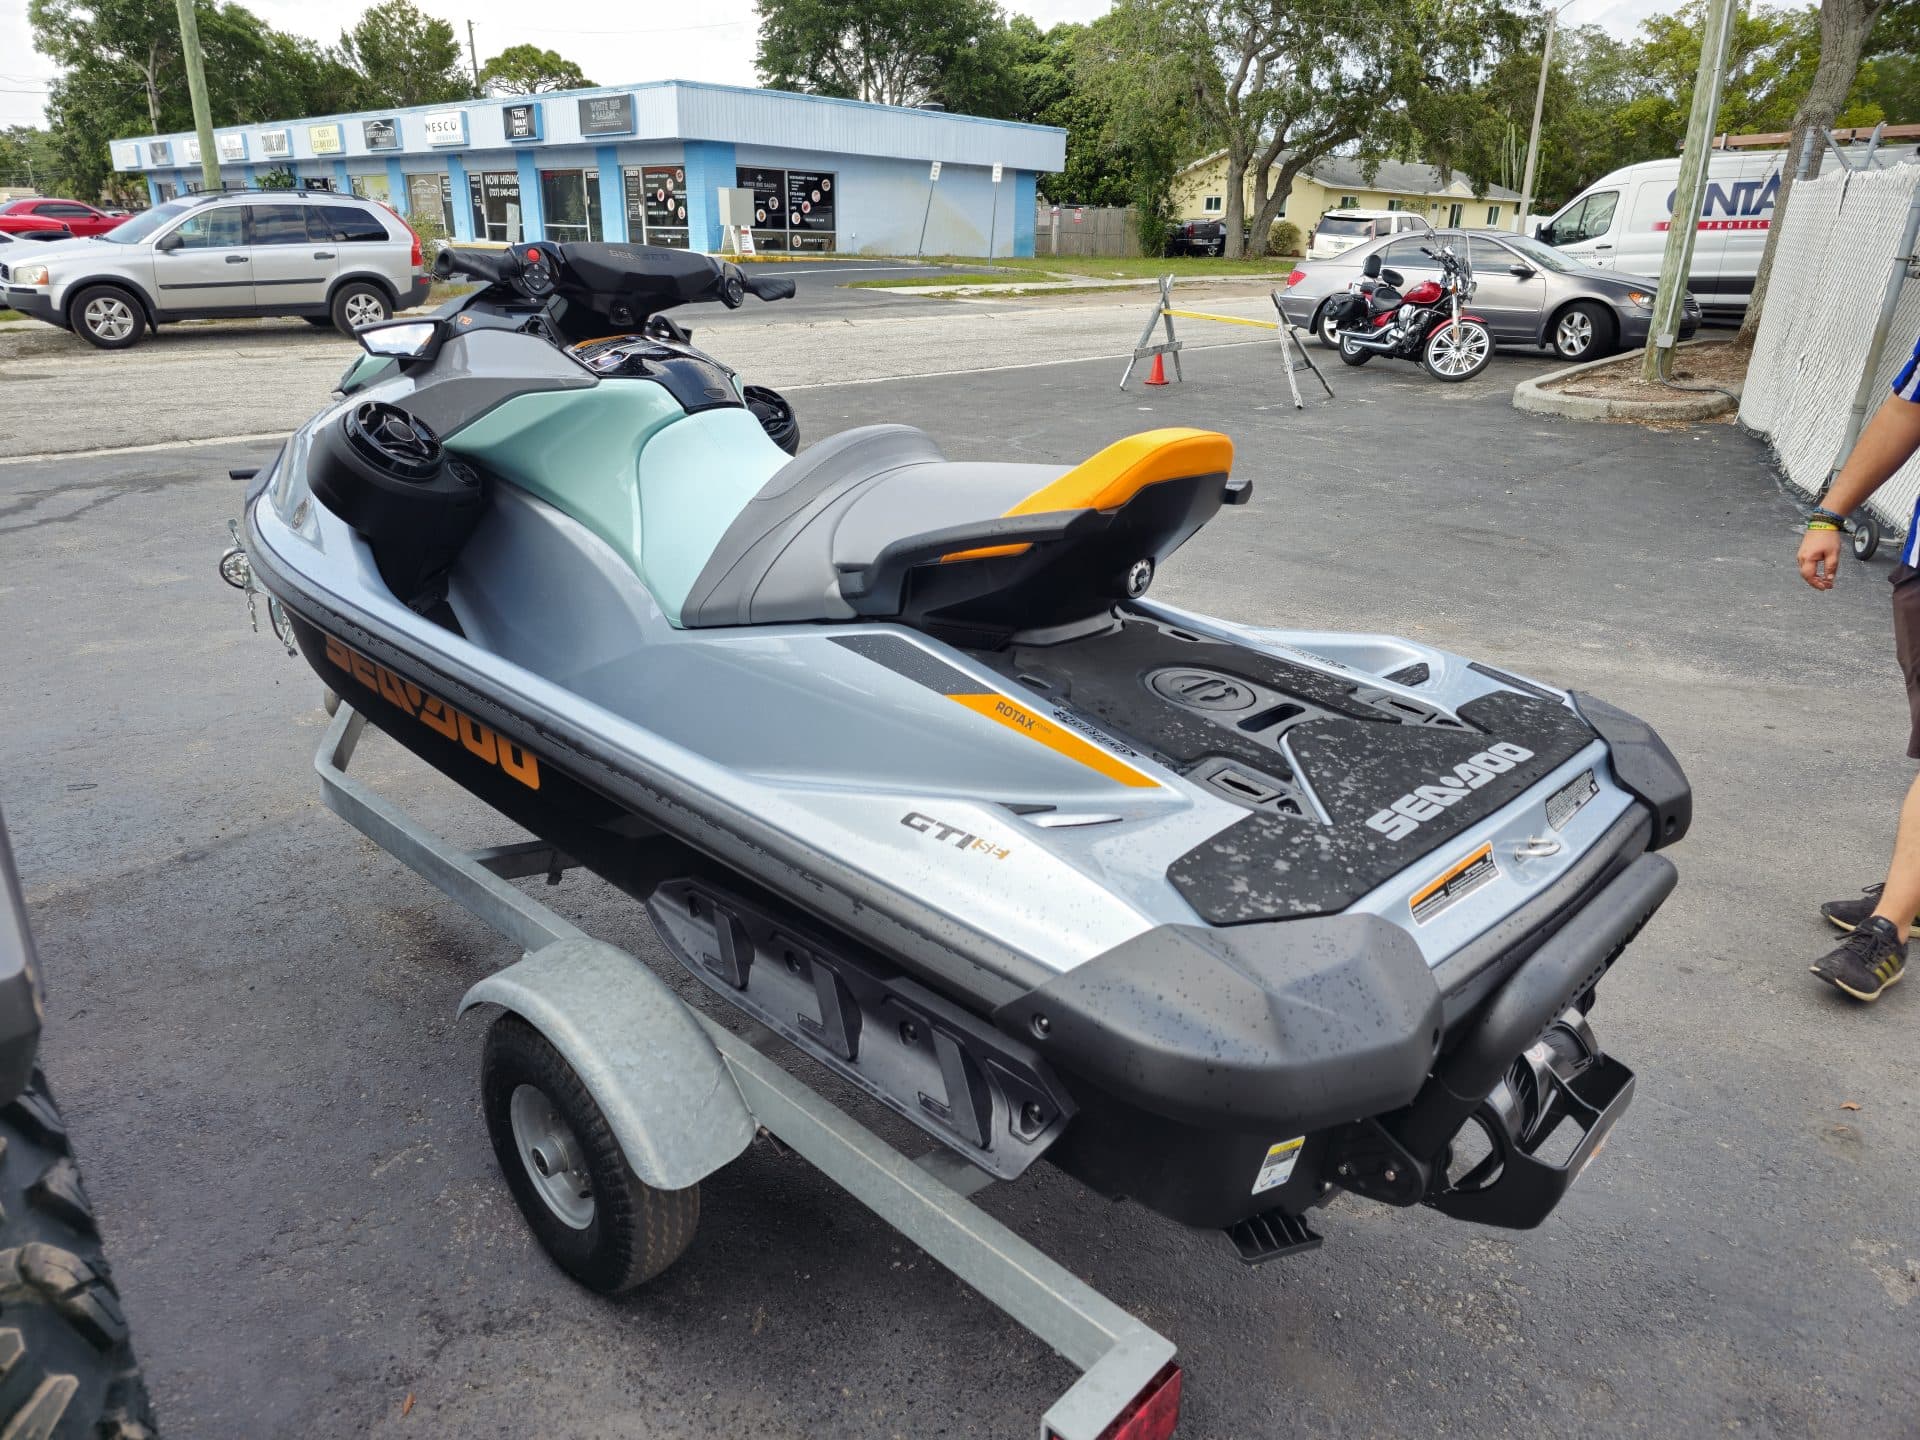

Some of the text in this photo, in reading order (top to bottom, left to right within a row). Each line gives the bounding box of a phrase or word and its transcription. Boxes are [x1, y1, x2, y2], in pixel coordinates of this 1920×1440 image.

[514, 110, 525, 118] THE
[515, 127, 526, 135] POT
[485, 174, 499, 185] NOW
[995, 701, 1036, 731] ROTAX
[900, 812, 977, 850] GTI
